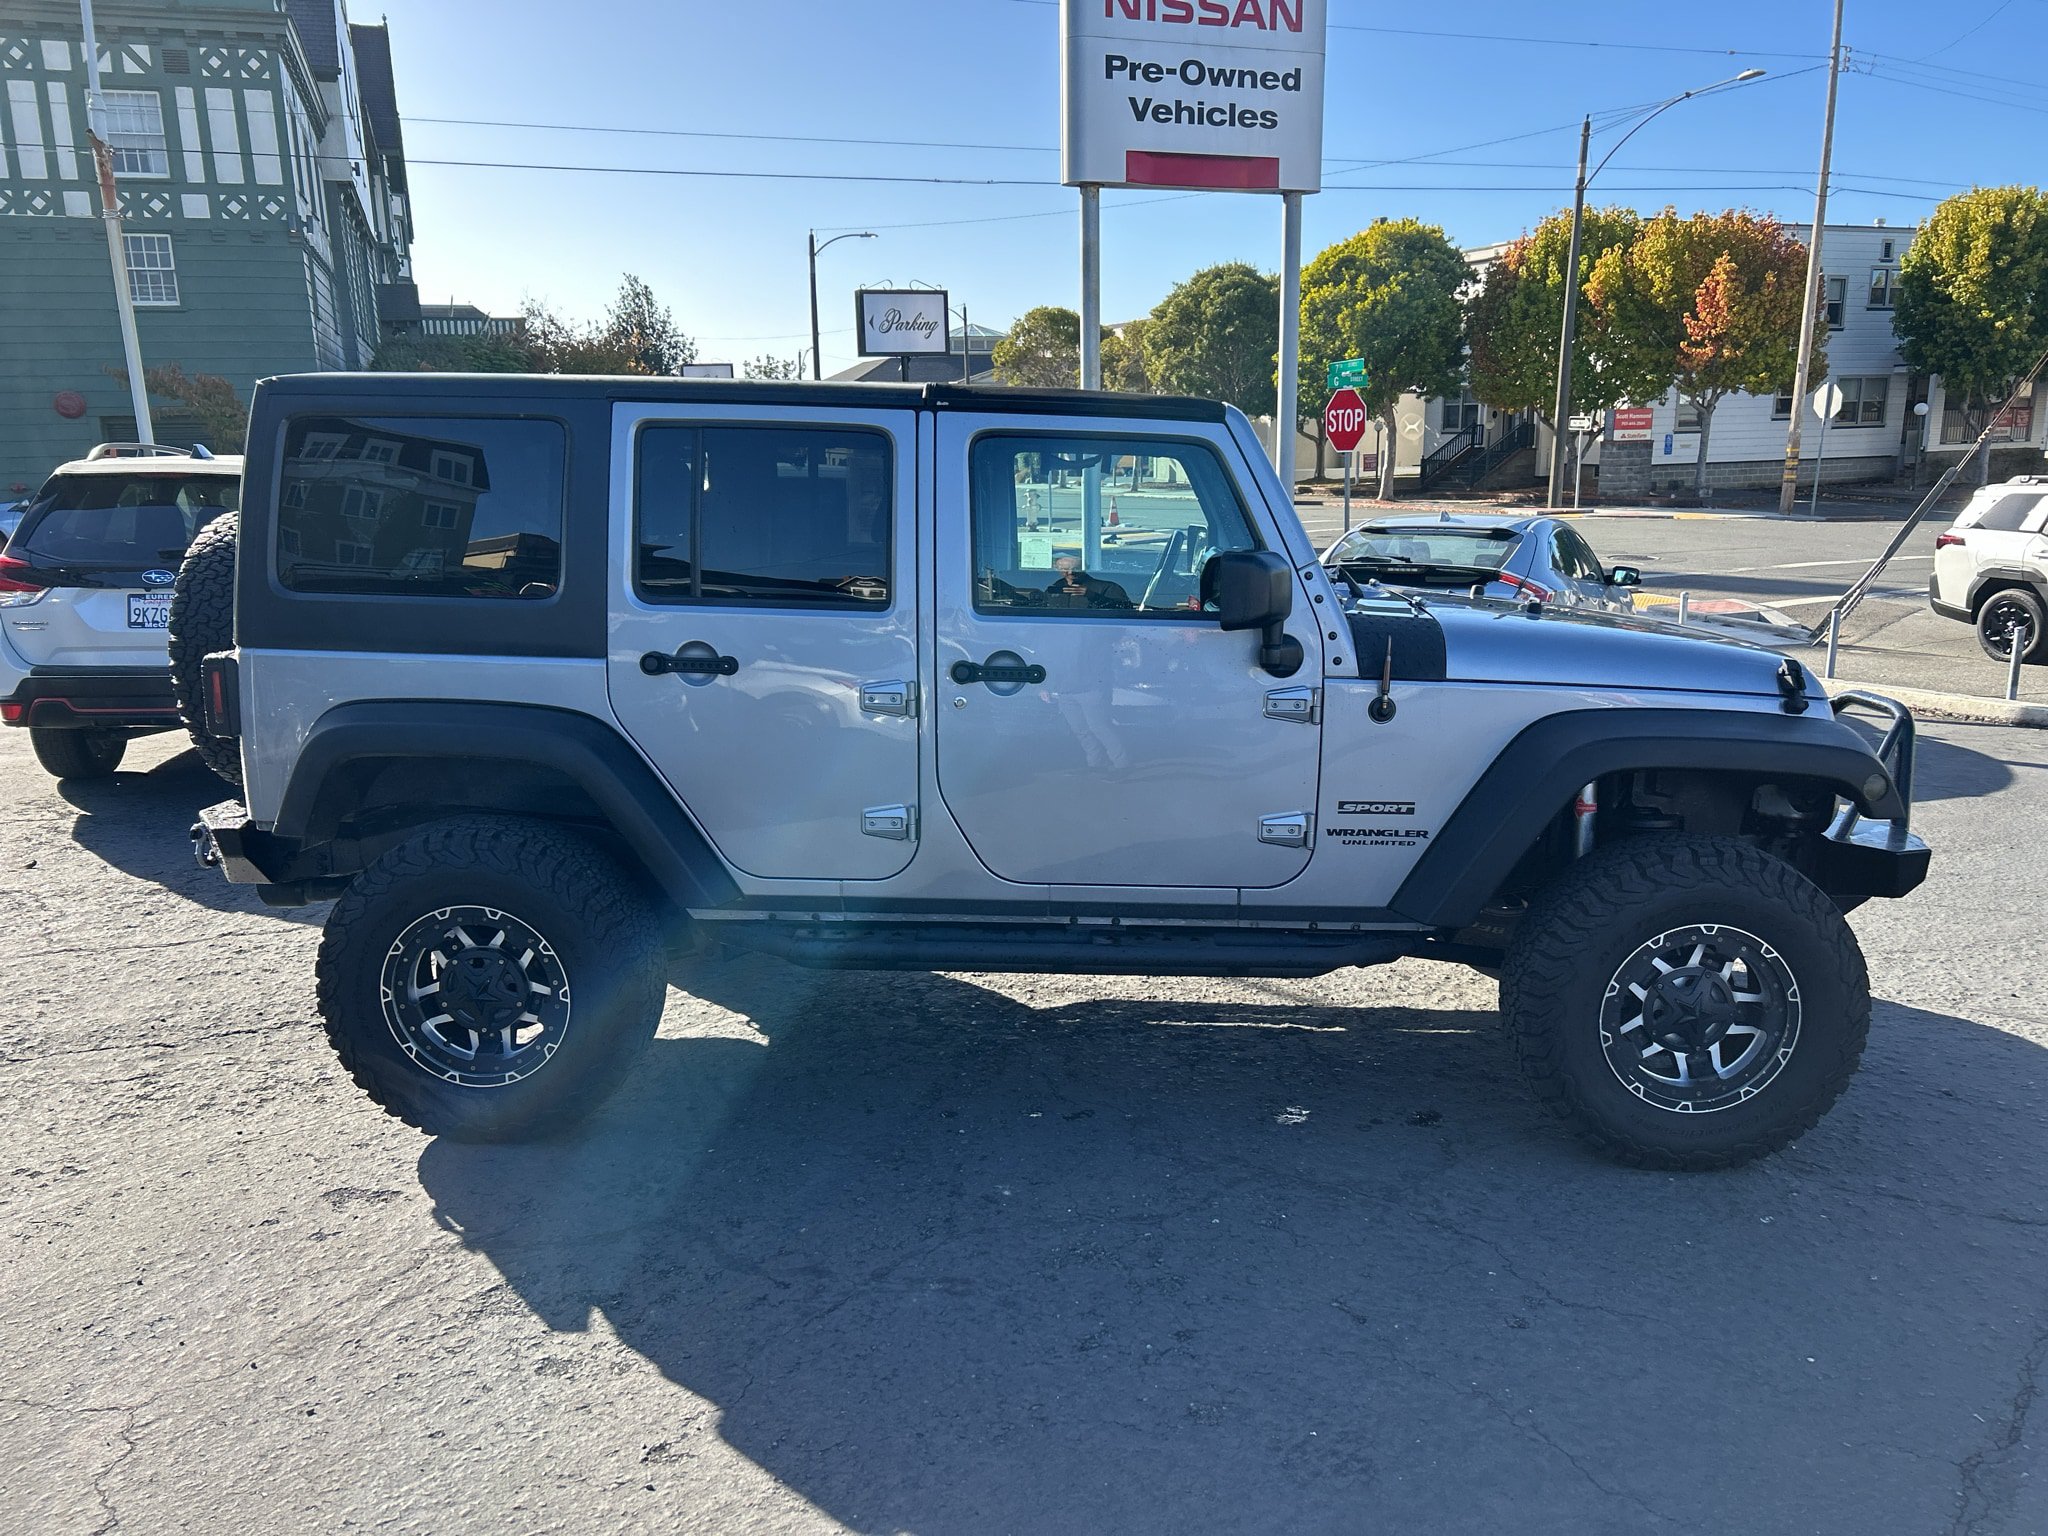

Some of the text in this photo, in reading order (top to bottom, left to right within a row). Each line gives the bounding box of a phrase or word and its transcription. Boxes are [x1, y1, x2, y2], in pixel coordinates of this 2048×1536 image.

[1105, 54, 1302, 92] Pre-Owned
[1128, 96, 1278, 130] Vehicles
[879, 308, 939, 339] Parking
[1333, 376, 1339, 387] G
[1328, 408, 1364, 433] STOP
[1342, 803, 1413, 813] SPORT
[1326, 828, 1430, 839] WRANGLER
